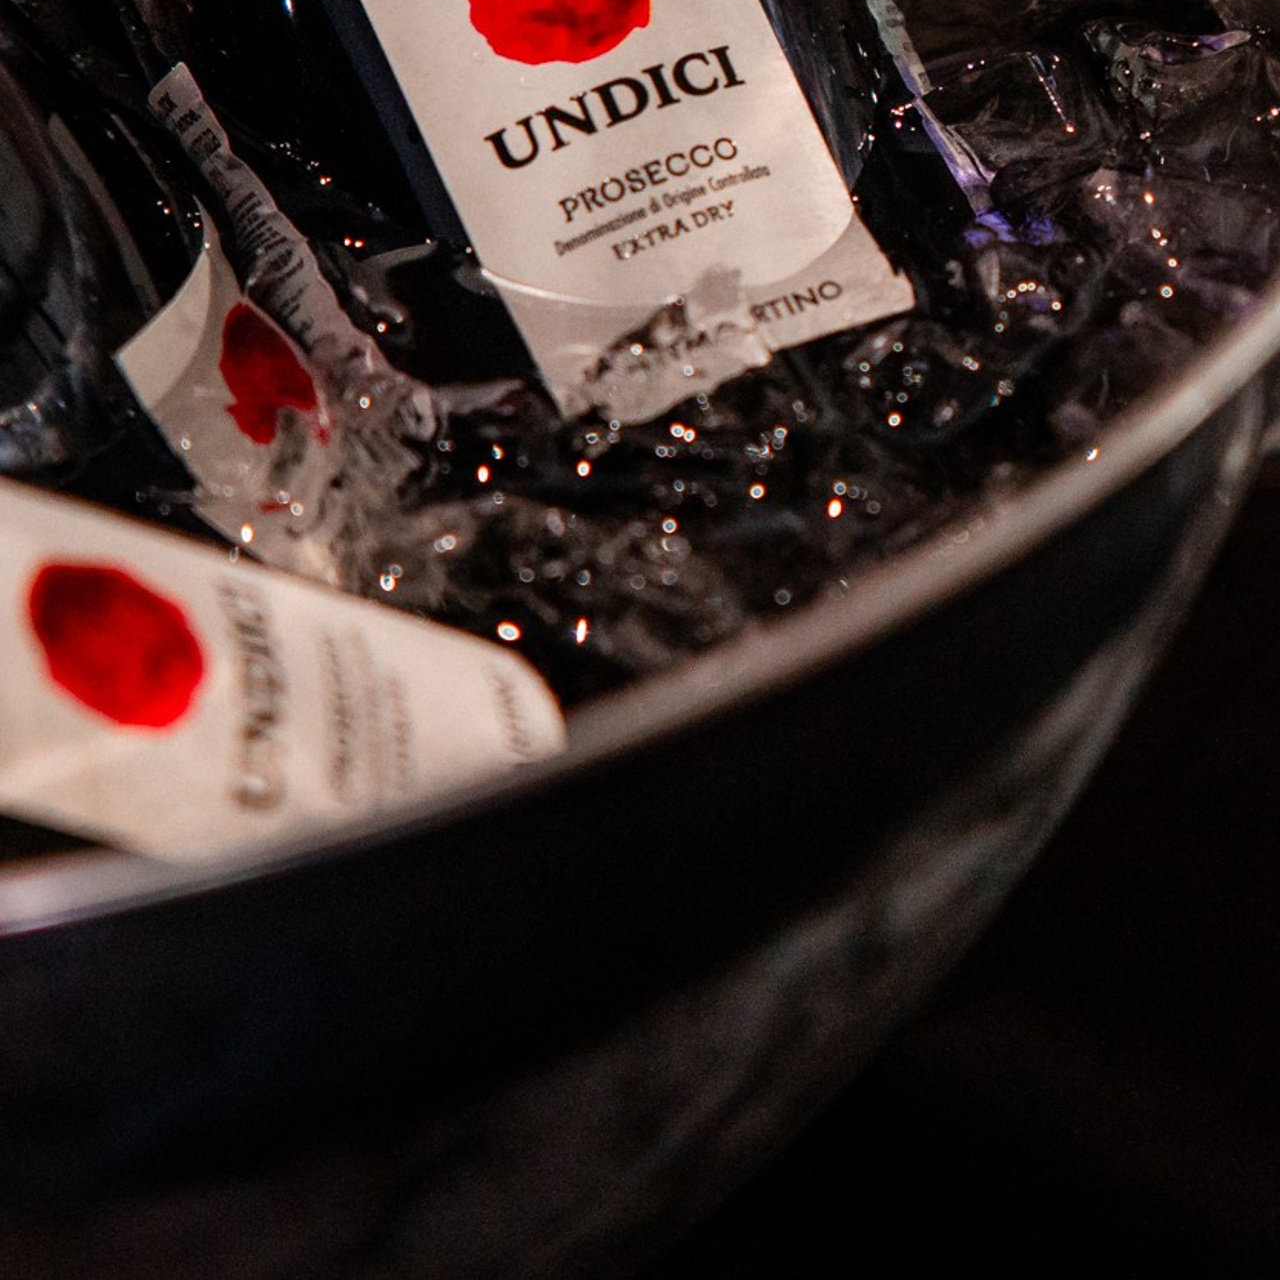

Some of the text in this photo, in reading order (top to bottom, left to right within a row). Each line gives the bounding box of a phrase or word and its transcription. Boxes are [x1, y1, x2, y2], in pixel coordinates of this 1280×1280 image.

[484, 46, 746, 170] UNDICI
[554, 164, 771, 256] Denominazione di Origine Controllata
[558, 137, 738, 222] PROSECCO
[611, 200, 734, 260] EXTRA DRY
